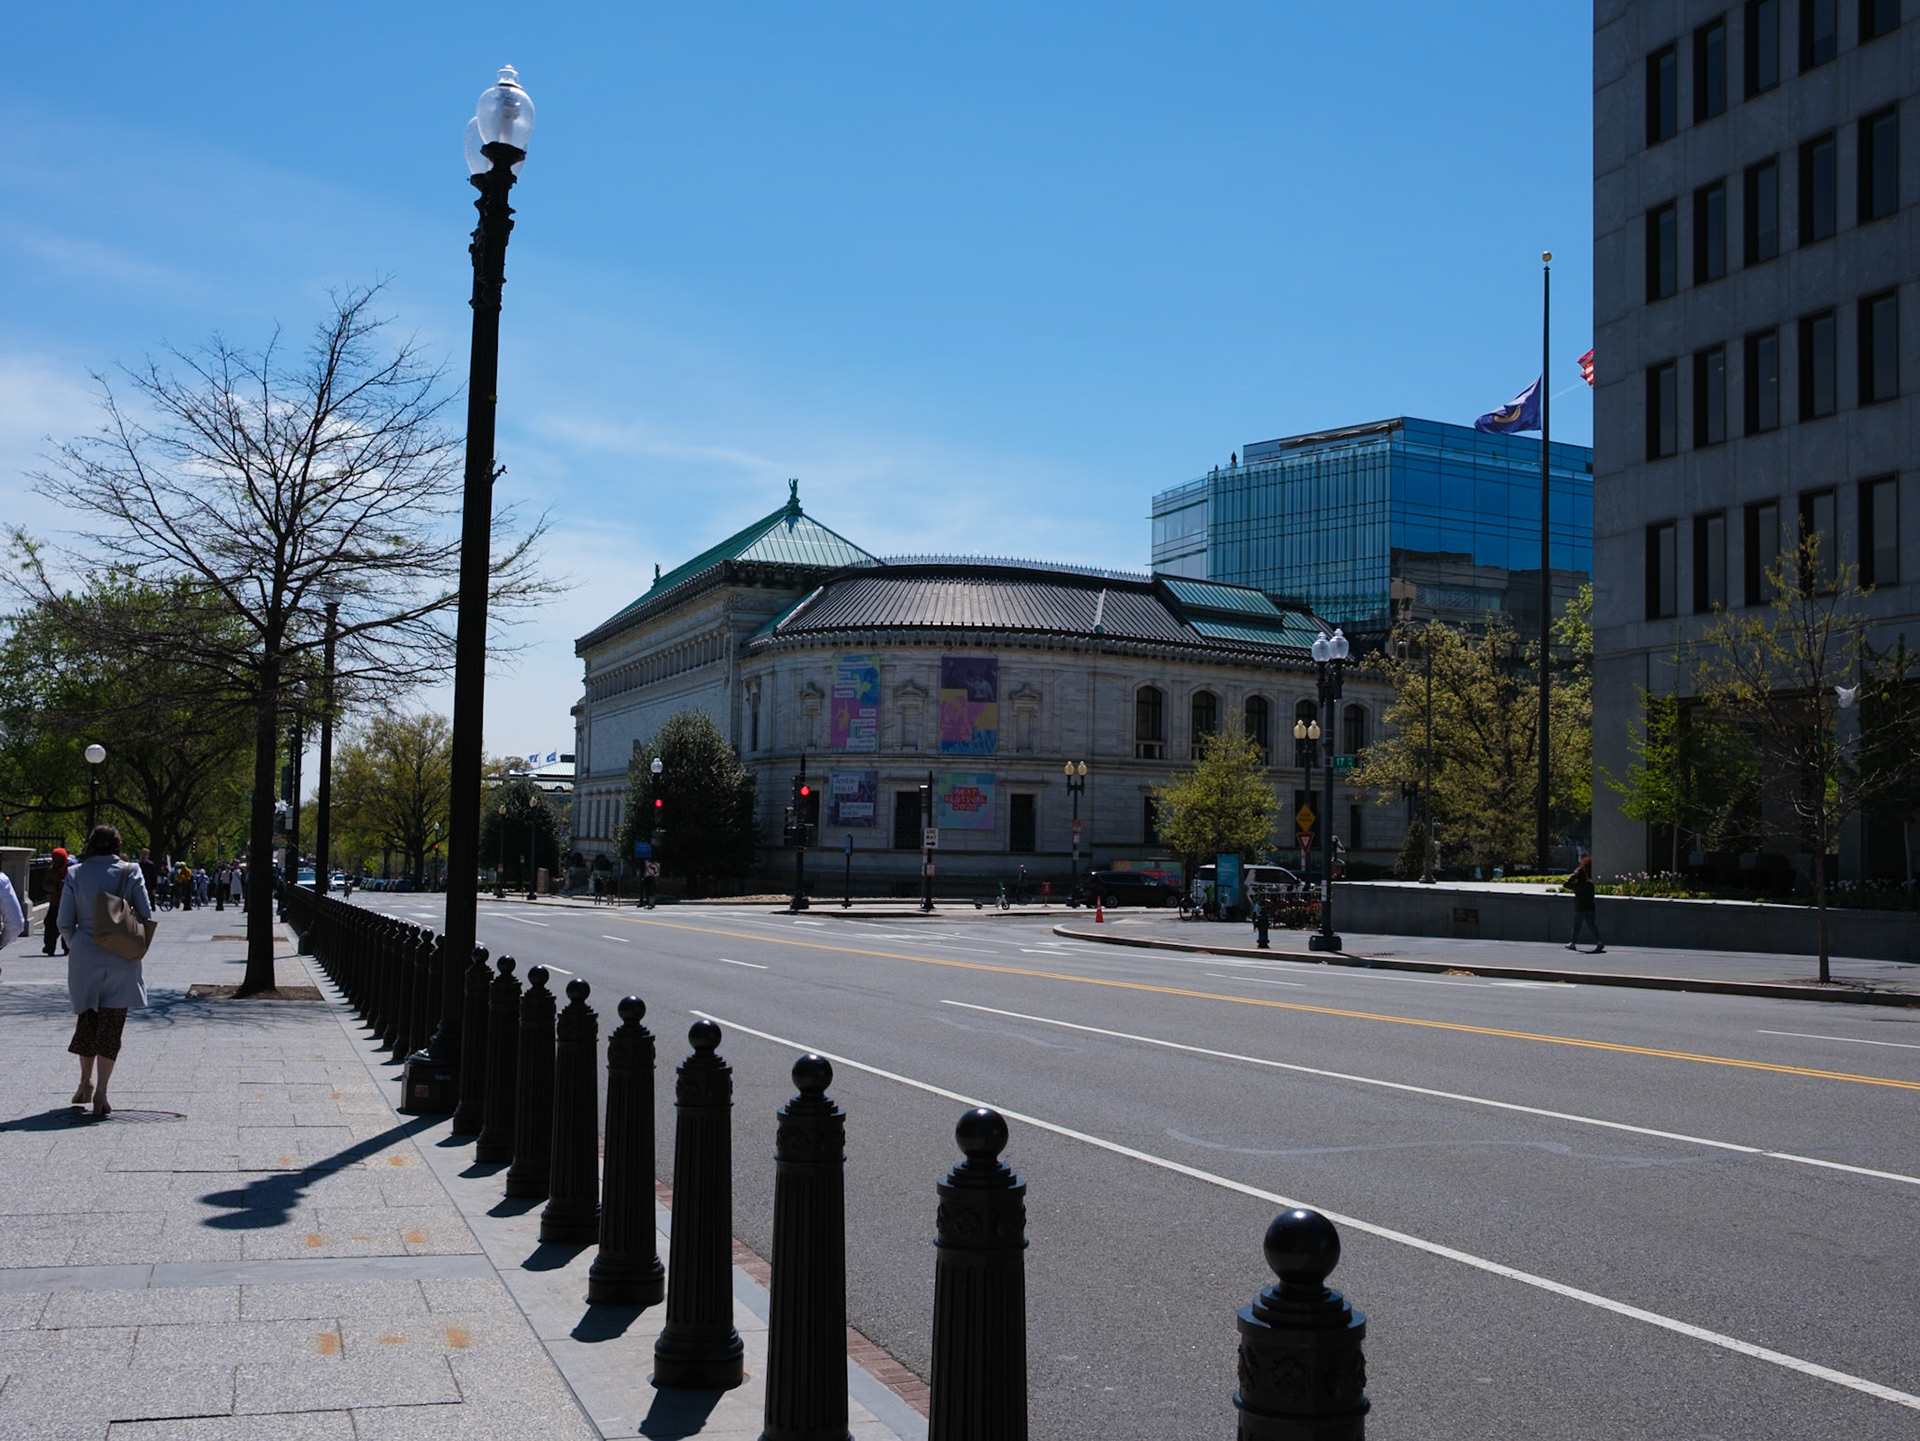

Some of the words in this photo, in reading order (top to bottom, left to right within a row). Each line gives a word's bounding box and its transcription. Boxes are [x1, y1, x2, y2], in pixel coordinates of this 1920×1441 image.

[1336, 757, 1344, 766] 17
[954, 788, 978, 796] NEXT
[945, 795, 987, 803] FESTIVAL
